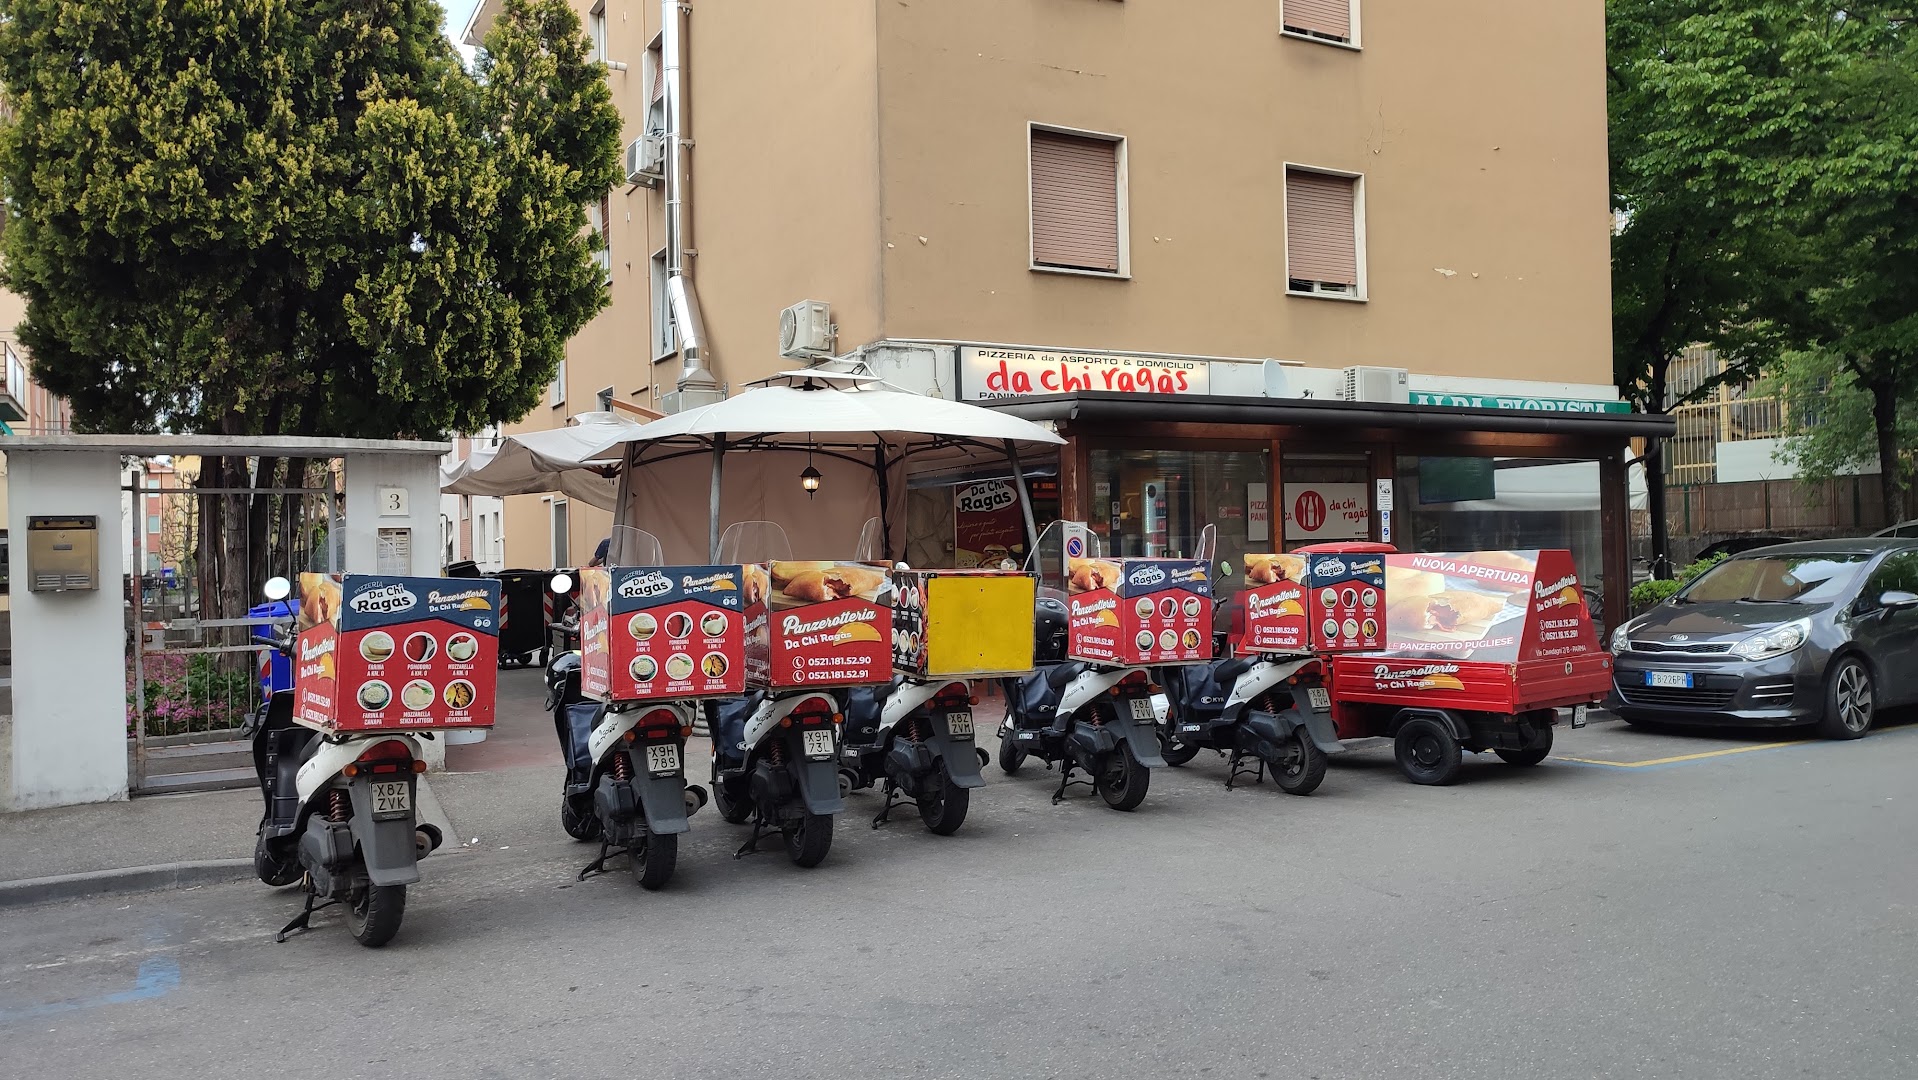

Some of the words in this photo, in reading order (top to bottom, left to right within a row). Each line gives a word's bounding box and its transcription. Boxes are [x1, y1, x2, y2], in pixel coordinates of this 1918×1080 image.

[978, 350, 1036, 361] PIZZERIA
[1060, 355, 1118, 365] ASPORTO
[1136, 359, 1194, 370] DOMICILIO
[986, 360, 1033, 393] da
[1040, 362, 1091, 392] chi
[1101, 367, 1188, 395] ragàs
[970, 486, 985, 497] Da
[987, 480, 1005, 493] Chi
[389, 493, 401, 511] 3
[960, 491, 1012, 512] Ragàs
[1329, 499, 1341, 511] da
[1342, 497, 1356, 510] chi
[1343, 507, 1368, 523] ragàs
[633, 576, 645, 586] Da
[647, 570, 663, 582] Chi
[1412, 557, 1457, 572] NUOVA
[1458, 562, 1529, 585] APERTURA
[354, 581, 384, 595] PIZZERIA
[369, 590, 384, 600] Da
[386, 583, 405, 596] Chi
[624, 581, 669, 597] Ragàs
[428, 588, 489, 604] Panzerotteria
[356, 595, 411, 613] Ragàs
[428, 605, 439, 613] Da
[782, 608, 877, 637] Panzerotteria
[784, 639, 800, 651] Da
[801, 636, 819, 647] Chi
[820, 631, 852, 643] Ragàs
[1400, 641, 1464, 650] PANZEROTTO
[1465, 637, 1514, 649] PUGLIESE
[808, 655, 872, 667] 0521.181.52.90
[808, 669, 869, 680] 0521.181.52.91
[1374, 663, 1460, 680] Panzerotteria
[1310, 688, 1326, 698] X8Z
[1376, 682, 1388, 690] Da
[1390, 681, 1405, 689] Chi
[1133, 700, 1150, 710] X8Z
[1314, 697, 1329, 706] ZVH
[950, 713, 970, 724] X8Z
[952, 723, 972, 734] ZVM
[807, 731, 829, 743] X9H
[651, 746, 674, 758] X9H
[808, 743, 831, 754] 73L
[652, 758, 676, 770] 789
[376, 783, 405, 798] X8Z
[378, 796, 406, 811] ZVK
